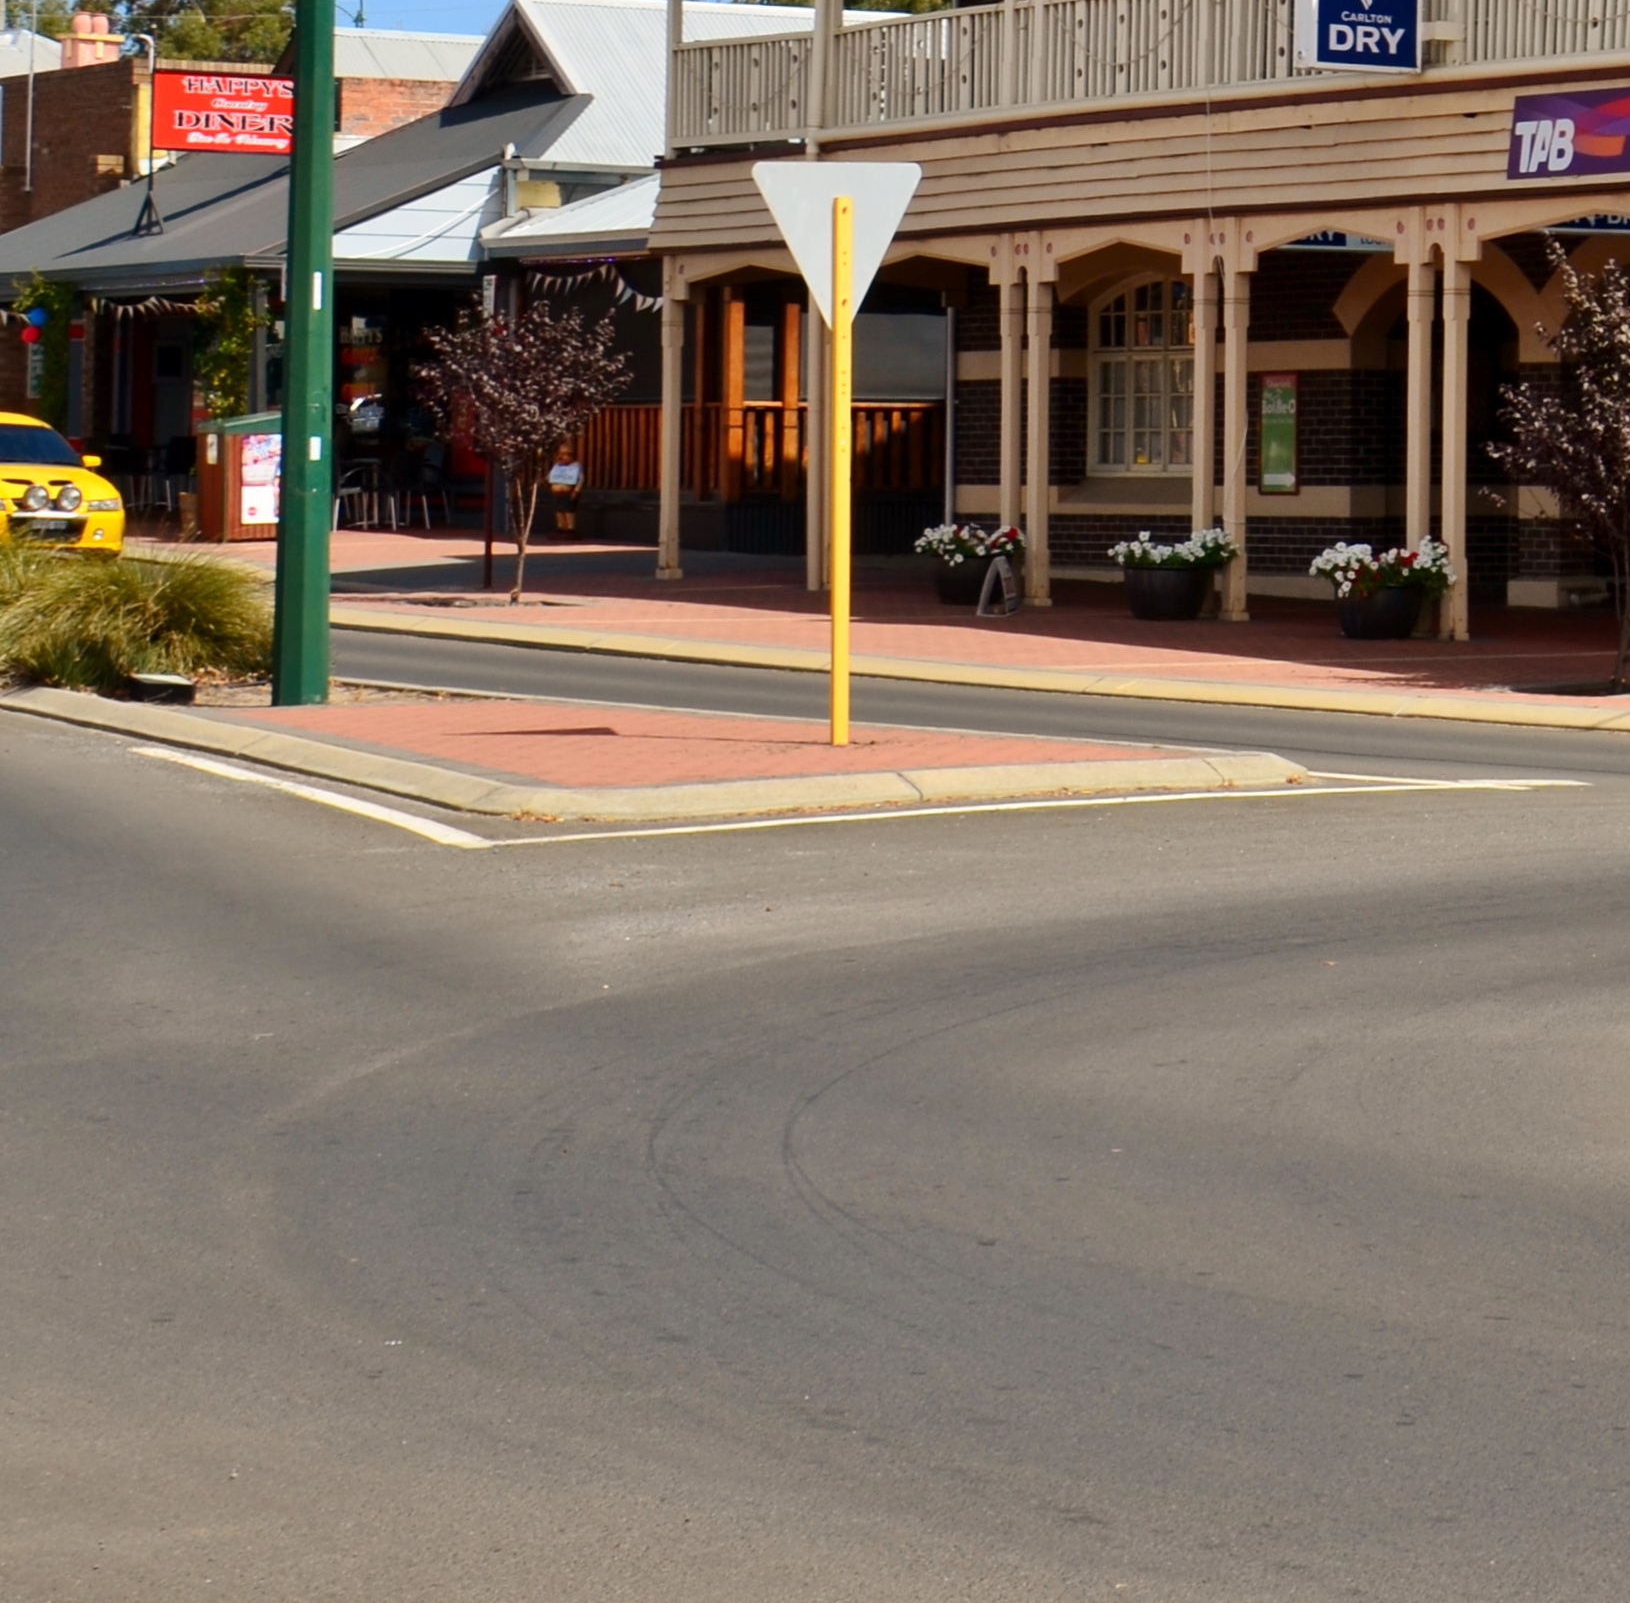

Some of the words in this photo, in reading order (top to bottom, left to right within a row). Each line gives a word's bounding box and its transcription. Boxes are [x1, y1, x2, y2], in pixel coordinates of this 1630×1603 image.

[1341, 10, 1392, 24] CARLTON
[1328, 22, 1405, 55] DRY
[173, 110, 293, 136] DINER
[1514, 118, 1575, 173] TAB
